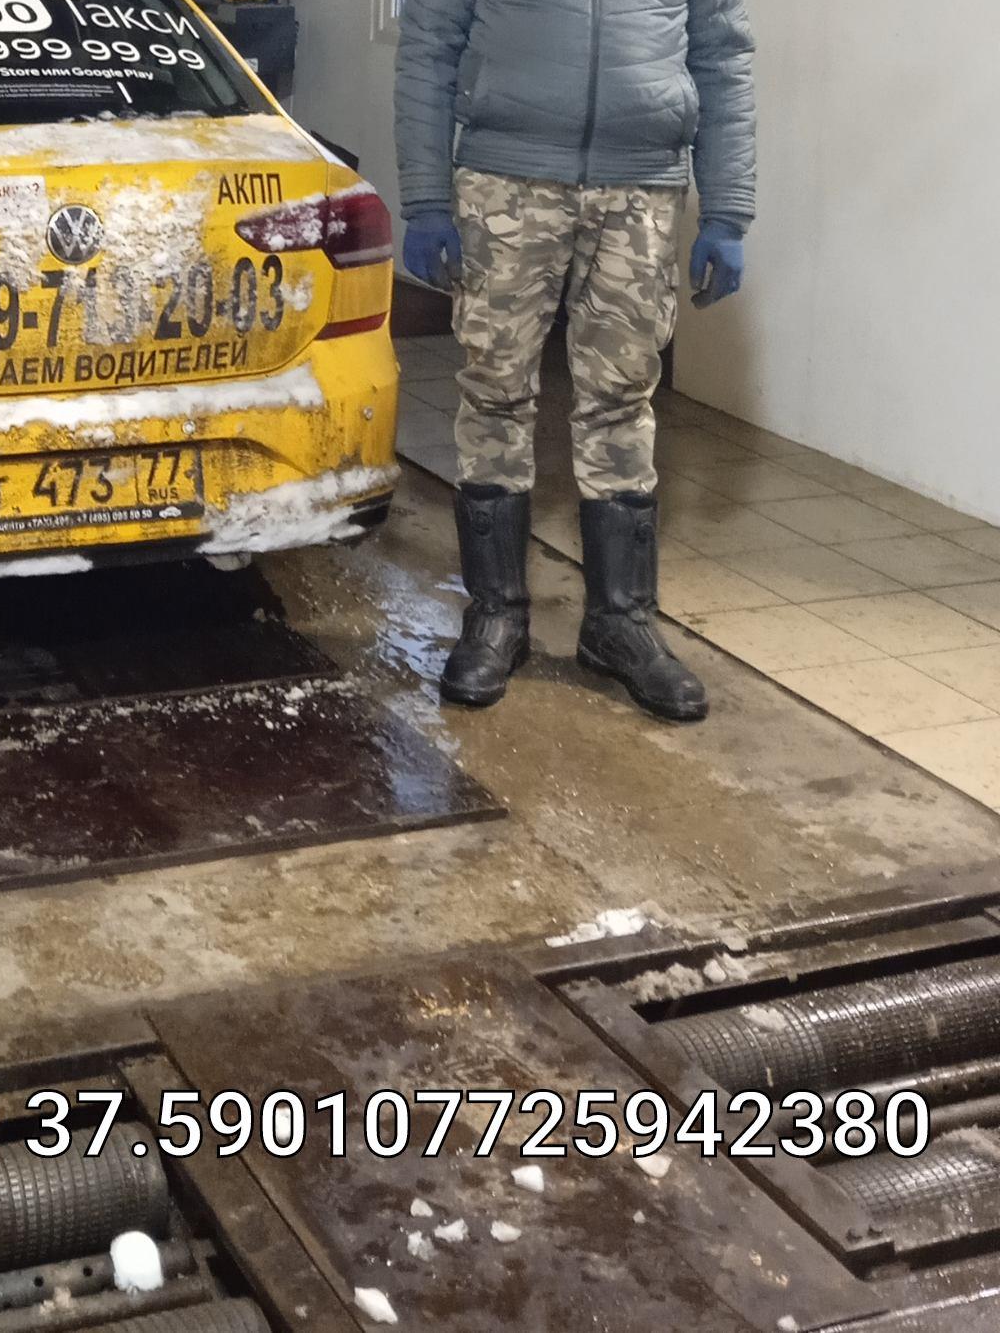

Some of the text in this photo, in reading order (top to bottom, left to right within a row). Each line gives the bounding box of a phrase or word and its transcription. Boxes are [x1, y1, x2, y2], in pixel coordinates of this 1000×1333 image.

[82, 39, 141, 62] 99
[149, 44, 206, 71] 99
[0, 67, 40, 77] Store
[41, 68, 71, 76] или
[71, 67, 124, 79] Google
[124, 69, 154, 80] Play
[218, 173, 282, 204] АКПП
[75, 332, 247, 383] ВОДИТЕЛЕЙ
[33, 457, 114, 507] 473
[141, 452, 180, 486] 77
[148, 487, 179, 501] RUS
